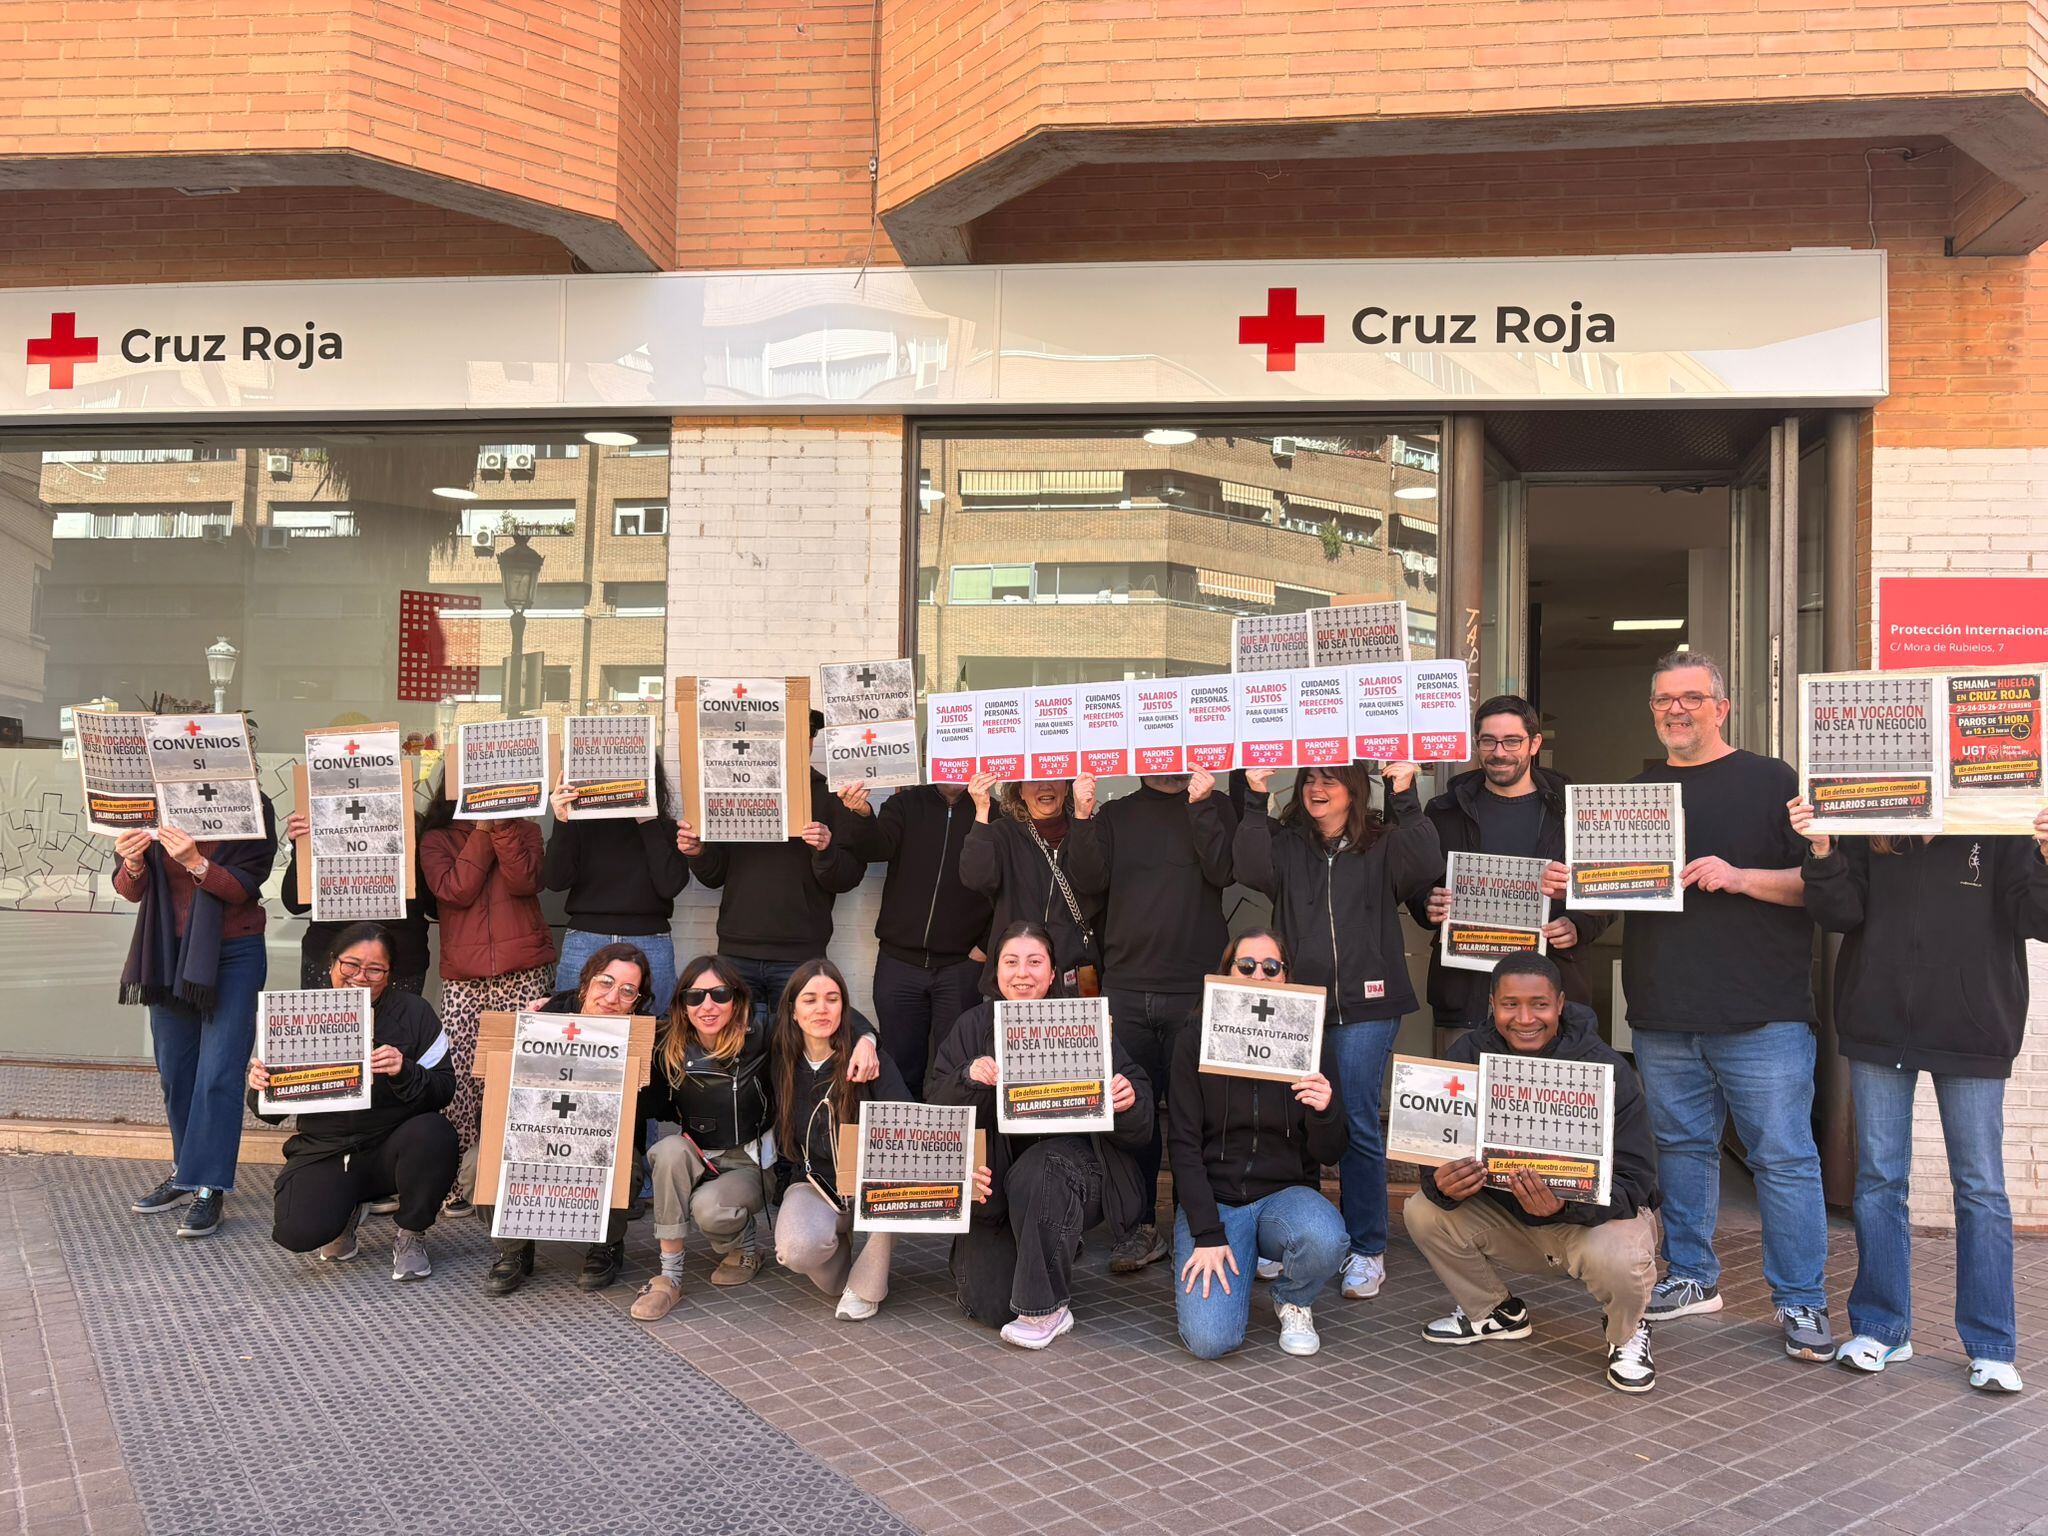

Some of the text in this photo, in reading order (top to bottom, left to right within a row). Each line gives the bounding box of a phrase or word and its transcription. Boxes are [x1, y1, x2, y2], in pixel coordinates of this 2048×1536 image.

[1352, 301, 1615, 353] Cruz Roja
[121, 321, 343, 369] Cruz Roja
[1891, 624, 1961, 635] Protección
[1890, 643, 2004, 653] C/ Mora de Rubielos, 7
[1359, 676, 1402, 687] SALARIOS
[1417, 672, 1457, 681] CUIDAMOS
[1953, 680, 1990, 689] SEMANA
[1998, 678, 2035, 688] HUELGA
[1138, 691, 1177, 701] SALARIOS
[1364, 686, 1397, 696] JUSTOS
[1415, 692, 1461, 701] MERECEMOS
[1969, 691, 1997, 701] CRUZ
[2001, 689, 2030, 699] ROJA
[828, 692, 908, 704] EXTRAESTATUTARIOS
[1086, 693, 1120, 702] CUIDAMOS
[703, 700, 779, 712] CONVENIOS
[937, 705, 972, 714] SALARIOS
[985, 700, 1018, 709] CUIDAMOS
[1143, 701, 1172, 710] JUSTOS
[859, 708, 879, 720] NO
[941, 714, 967, 723] JUSTOS
[1084, 711, 1123, 720] MERECEMOS
[1365, 709, 1398, 717] CUIDAMOS
[1815, 707, 1838, 719] QUE
[1843, 707, 1856, 718] MI
[983, 718, 1021, 726] MERECEMOS
[1144, 722, 1174, 730] CUIDAMOS
[1815, 718, 1926, 730] NO SEA TU NEGOCIO
[1958, 717, 1986, 726] PAROS
[2005, 715, 2029, 723] HORA
[735, 722, 745, 732] SI
[153, 737, 240, 751] CONVENIOS
[1422, 735, 1457, 744] PARONES
[833, 743, 909, 760] CONVENIOS
[1962, 746, 1986, 755] UGT
[193, 759, 206, 770] SI
[313, 755, 394, 770] CONVENIOS
[733, 774, 750, 783] NO
[866, 767, 876, 778] SI
[348, 778, 359, 789] SI
[1821, 800, 1865, 811] ¡SALARIOS
[1880, 798, 1908, 806] SECTOR
[1910, 796, 1924, 804] YA!
[169, 806, 251, 815] EXTRAESTATUTARIOS
[1578, 810, 1597, 821] QUE
[1600, 809, 1613, 819] MI
[202, 819, 222, 830] NO
[315, 825, 399, 835] EXTRAESTATUTARIOS
[1578, 820, 1670, 831] NO SEA TU NEGOCIO
[347, 840, 367, 852] NO
[270, 1015, 289, 1026] QUE
[292, 1014, 304, 1025] MI
[270, 1023, 360, 1037] NO SEA TU NEGOCIO
[1006, 1027, 1026, 1039] QUE
[1030, 1026, 1041, 1039] MI
[1213, 1024, 1309, 1043] EXTRAESTATUTARIOS
[522, 1040, 619, 1059] CONVENIOS
[1007, 1036, 1098, 1051] NO SEA TU NEGOCIO
[1247, 1044, 1272, 1060] NO
[559, 1068, 573, 1081] SI
[1492, 1084, 1514, 1098] QUE
[1518, 1086, 1531, 1100] MI
[1013, 1095, 1099, 1113] ¡SALARIOS DEL SECTOR YA!
[1491, 1098, 1598, 1120] NO SEA TU NEGOCIO
[510, 1123, 612, 1137] EXTRAESTATUTARIOS
[870, 1127, 891, 1139] QUE
[894, 1128, 906, 1140] MI
[1443, 1128, 1458, 1144] SI
[546, 1143, 571, 1157] NO
[870, 1139, 962, 1152] NO SEA TU NEGOCIO
[509, 1183, 531, 1195] QUE
[532, 1184, 544, 1196] MI
[507, 1195, 599, 1211] NO SEA TU NEGOCIO
